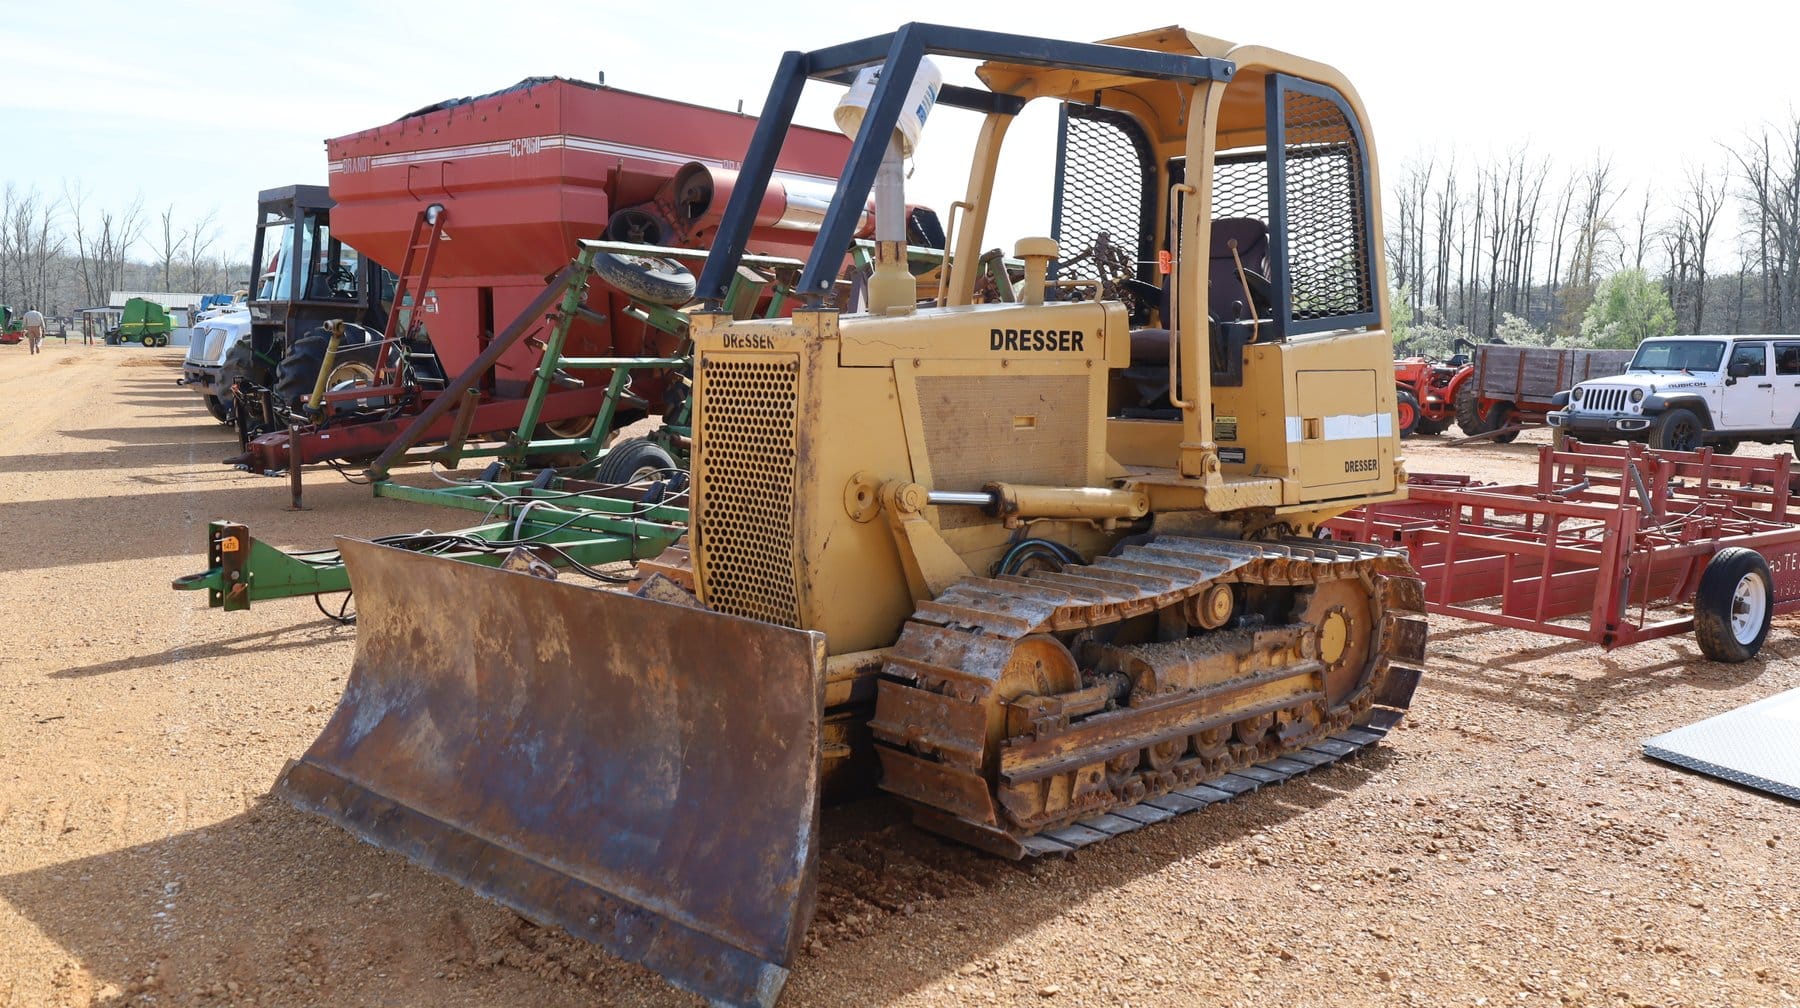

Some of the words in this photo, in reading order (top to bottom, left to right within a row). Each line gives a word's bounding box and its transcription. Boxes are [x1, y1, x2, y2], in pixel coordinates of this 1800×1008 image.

[343, 156, 370, 174] BRANDT
[990, 328, 1084, 352] DRESSER
[1344, 459, 1378, 473] DRESSER
